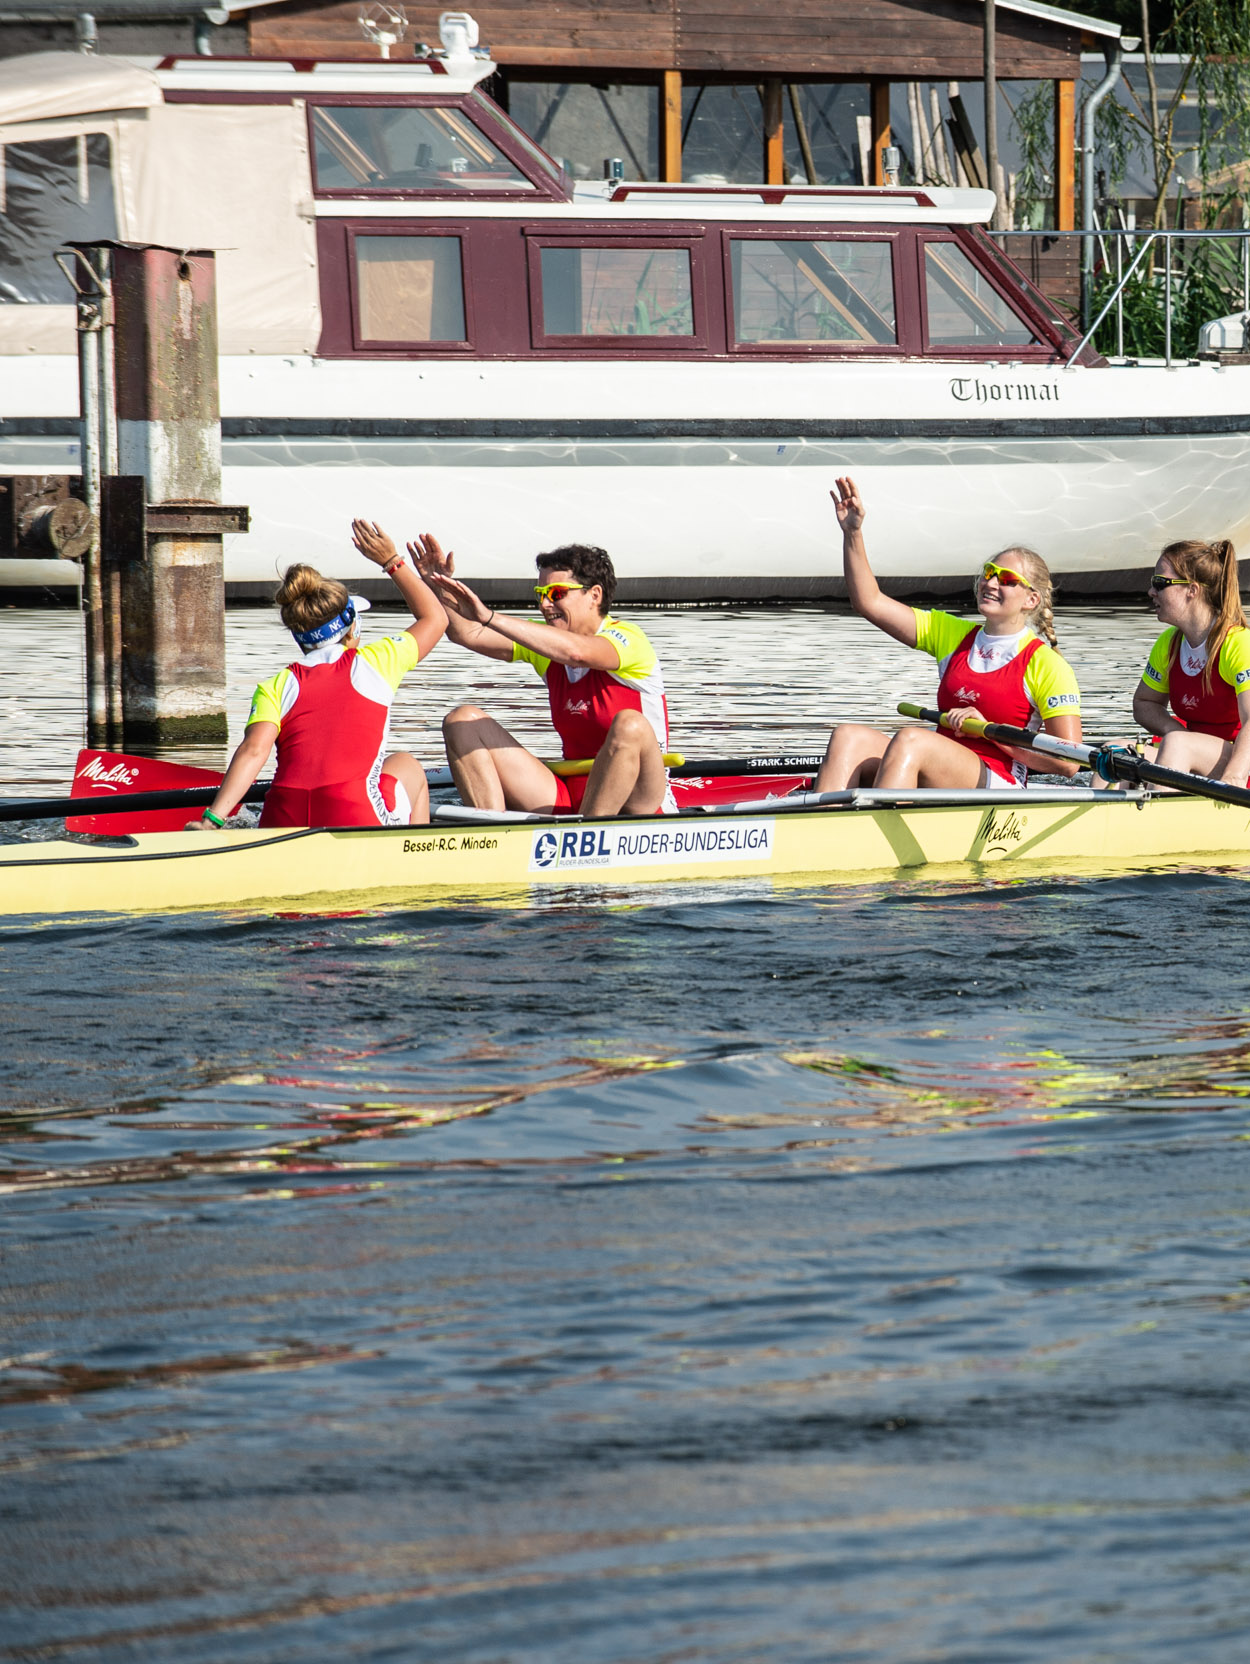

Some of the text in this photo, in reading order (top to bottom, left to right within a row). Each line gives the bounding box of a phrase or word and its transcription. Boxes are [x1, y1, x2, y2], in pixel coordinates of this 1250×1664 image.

[949, 378, 1059, 405] Thormai
[310, 629, 324, 641] NK
[328, 619, 342, 633] NK
[610, 629, 629, 646] RBL
[1060, 695, 1079, 704] RBL
[77, 756, 133, 785] Melitta
[751, 758, 782, 767] STARK.
[974, 807, 1021, 843] Melitta
[403, 837, 498, 853] Bessel-R.C. Minden
[561, 830, 611, 857] RBL
[617, 828, 768, 856] RUDER-BUNDESLIGA
